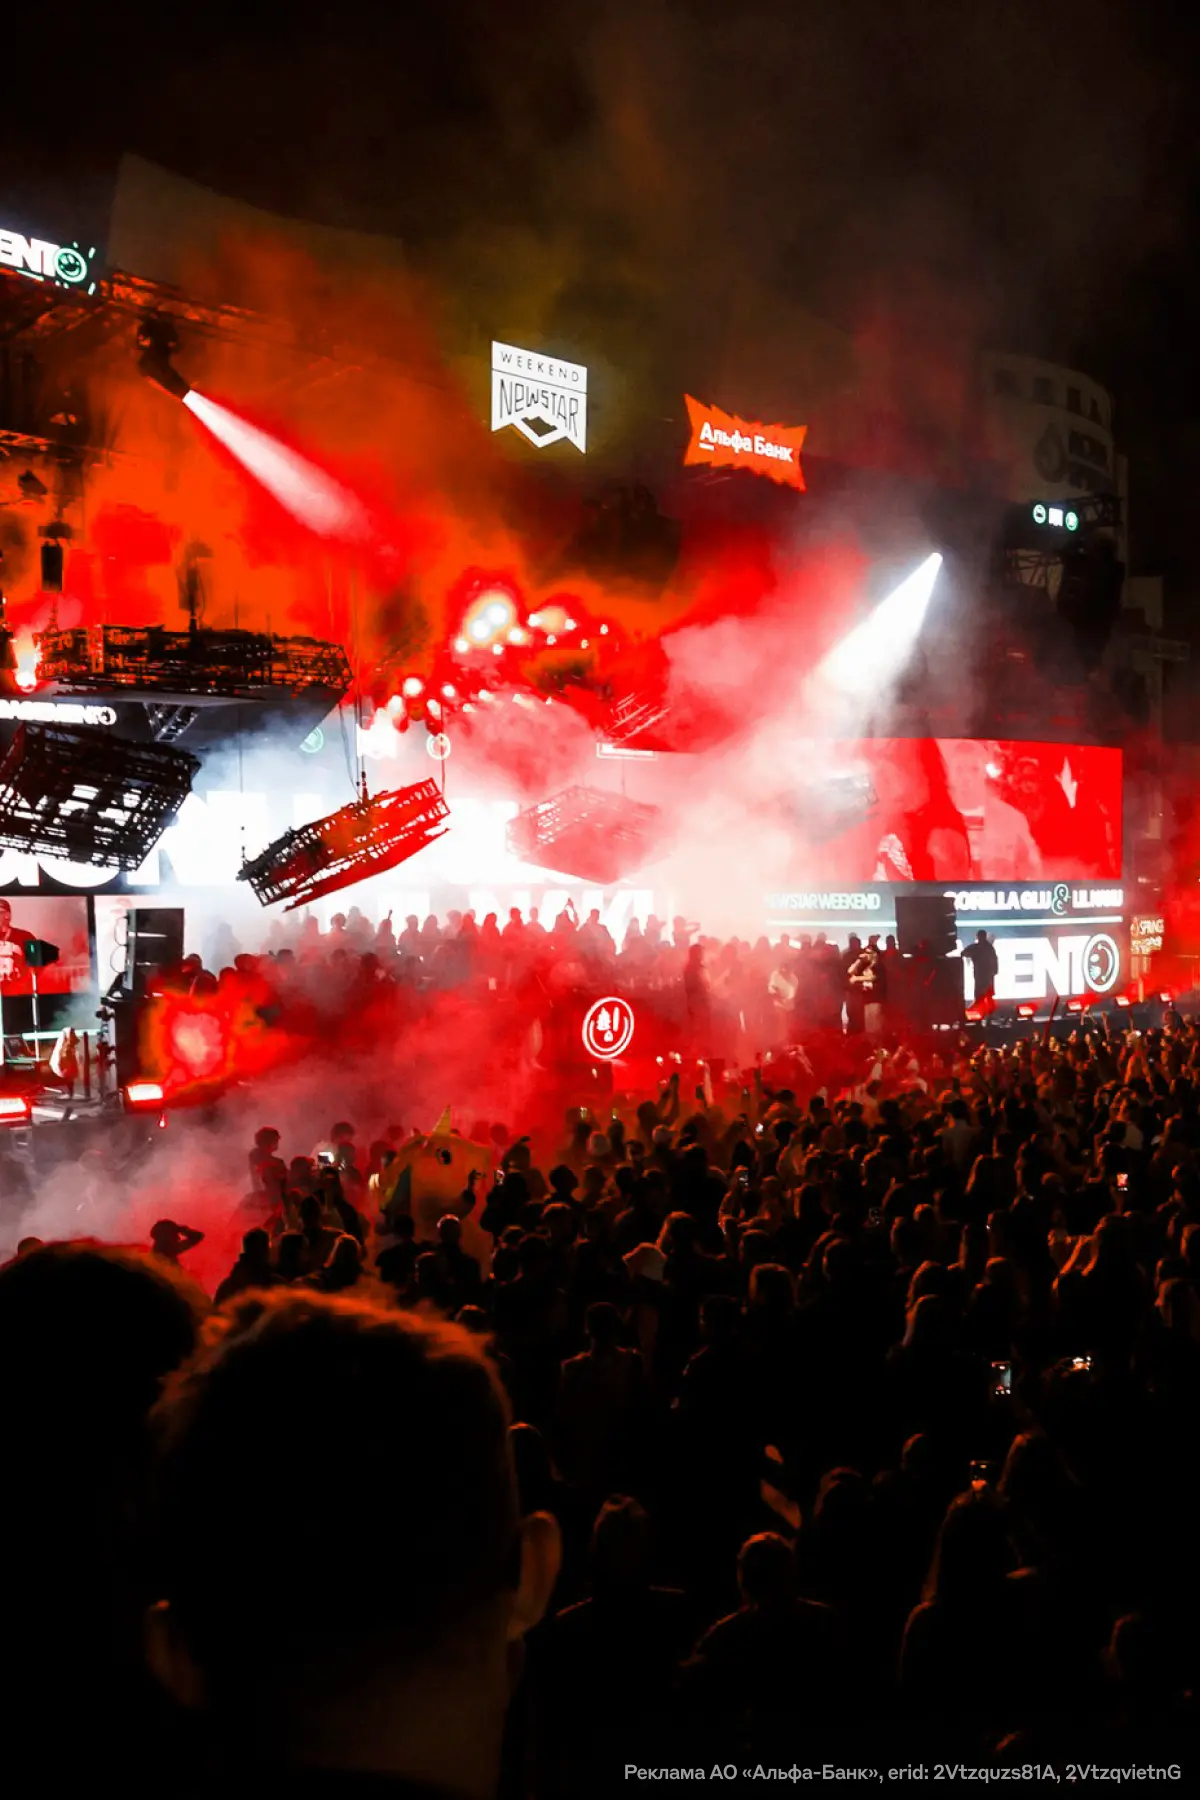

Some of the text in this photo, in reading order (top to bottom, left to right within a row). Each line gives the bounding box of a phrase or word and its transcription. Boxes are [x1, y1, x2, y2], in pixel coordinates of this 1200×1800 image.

[501, 351, 579, 382] WEEKEND
[700, 421, 793, 462] Альфа Банк
[818, 893, 881, 910] WEEKEND
